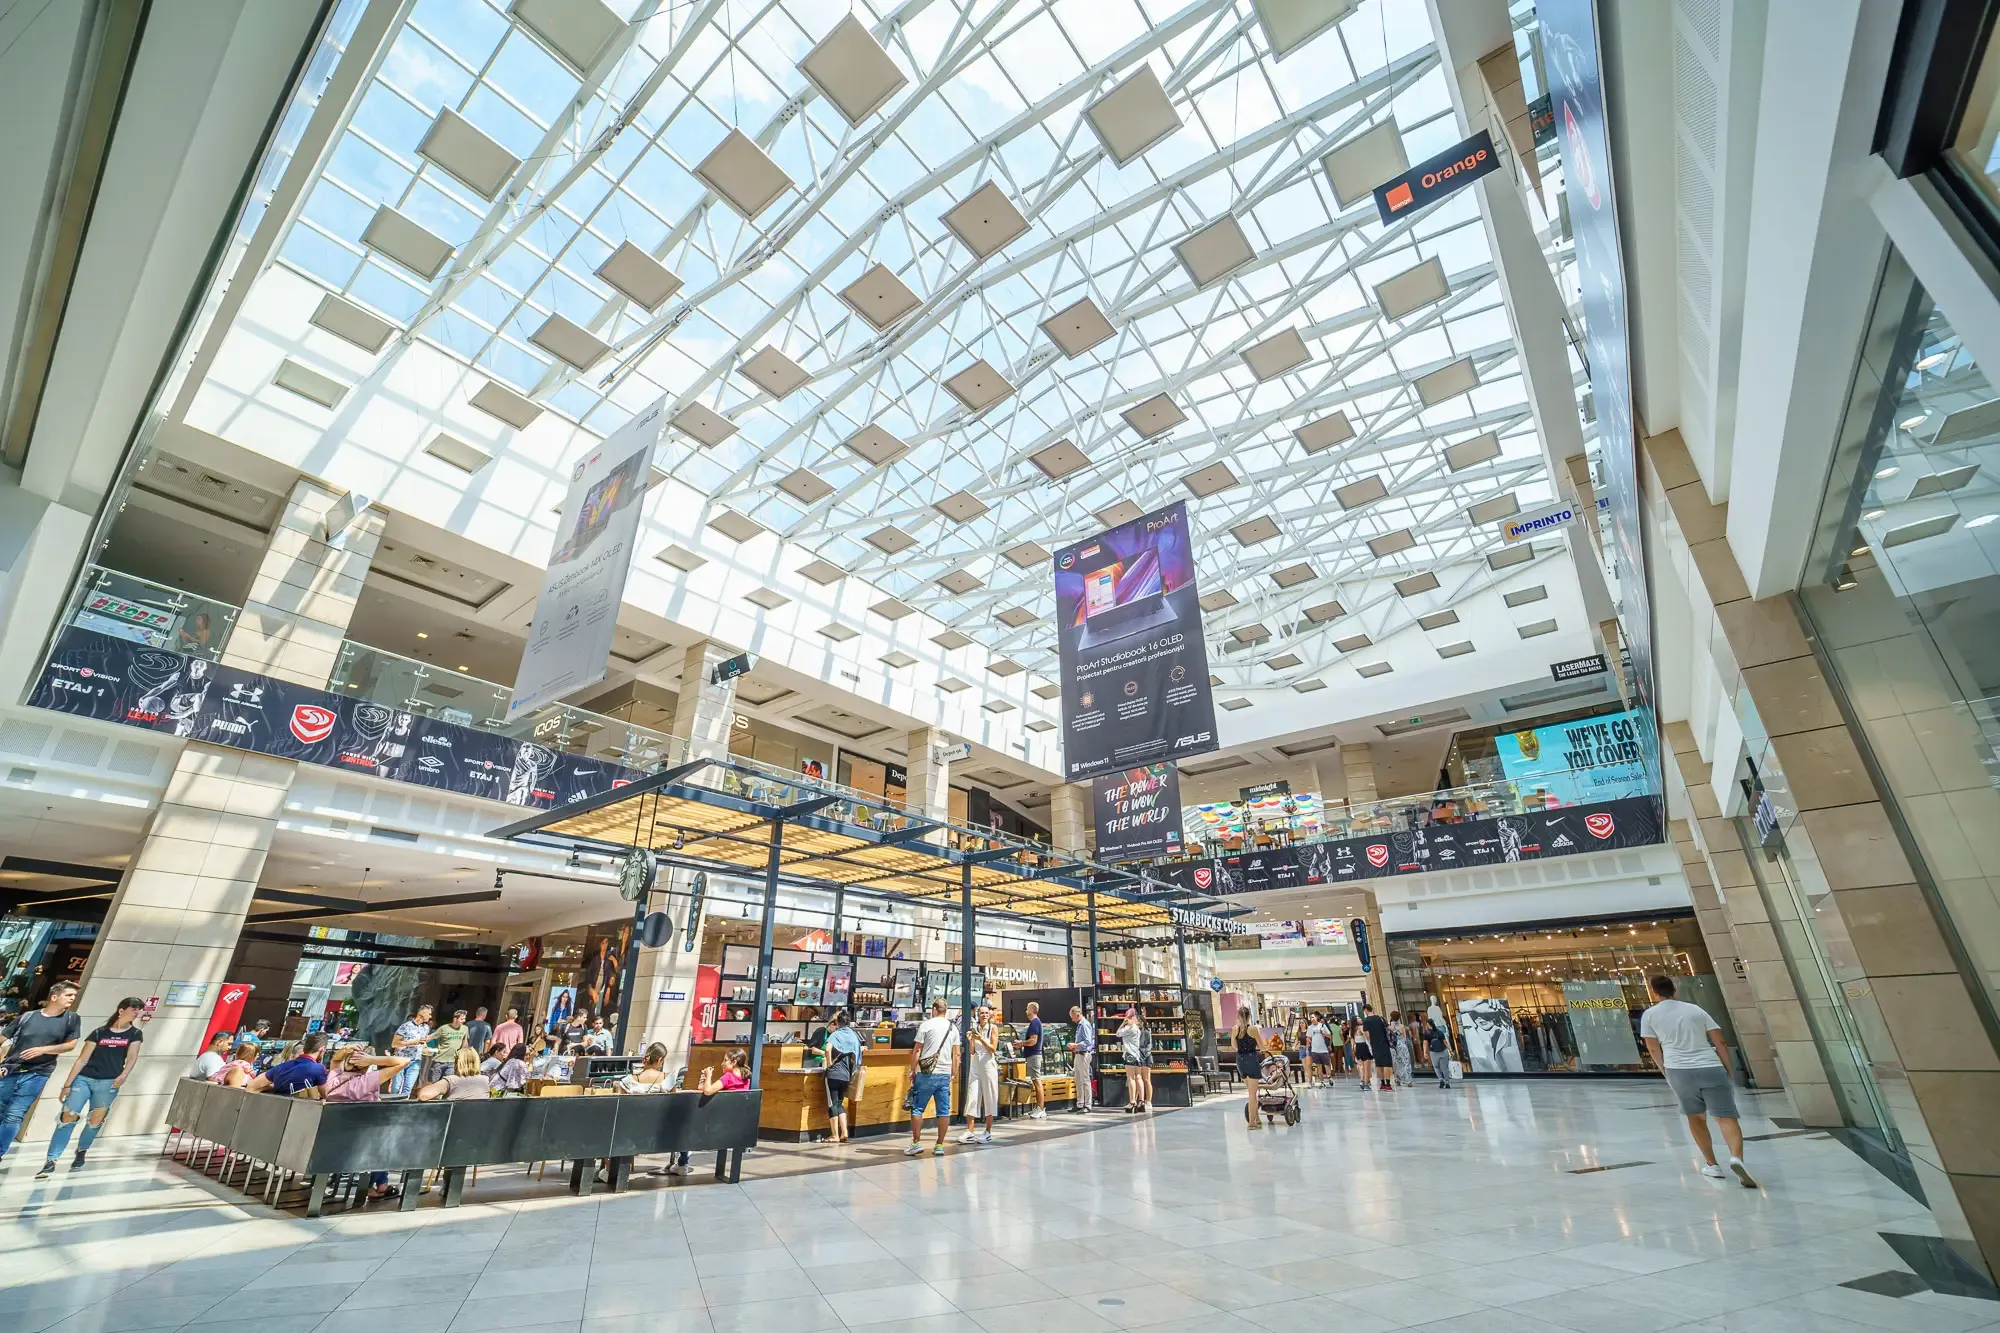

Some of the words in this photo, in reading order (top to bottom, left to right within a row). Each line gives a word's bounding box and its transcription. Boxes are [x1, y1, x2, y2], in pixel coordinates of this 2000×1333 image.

[1421, 149, 1488, 189] Orange
[1146, 513, 1179, 533] ProArt
[1510, 510, 1572, 536] IMPRINTO
[1076, 659, 1101, 674] ProArt
[1101, 645, 1147, 667] Studiobook
[1148, 641, 1159, 652] 16
[1159, 633, 1184, 647] OLED
[51, 662, 81, 674] SPORT
[93, 672, 120, 683] VISION
[1102, 664, 1123, 676] pentru
[1122, 656, 1147, 668] creatorii
[1566, 669, 1580, 677] LASER
[52, 678, 93, 695] ETAJ
[97, 688, 105, 697] 1
[128, 711, 158, 723] LEAP
[533, 715, 562, 738] IQOS
[211, 719, 247, 735] PUMA
[421, 735, 453, 748] ellesse
[1174, 732, 1212, 748] ASUS
[1566, 723, 1612, 751] WE'VE
[464, 757, 484, 766] SPORT
[492, 764, 512, 773] VISION
[1080, 758, 1104, 769] Windows
[1563, 748, 1596, 771] YOU
[418, 765, 440, 774] umbro
[469, 770, 493, 782] ETAJ
[494, 776, 500, 784] 1
[1104, 784, 1129, 803] THE
[1130, 774, 1168, 797] POWER
[1593, 777, 1605, 787] End
[1605, 776, 1611, 785] of
[1611, 774, 1631, 784] Season
[1630, 772, 1646, 781] Sale!
[1114, 800, 1129, 815] TO
[1131, 790, 1160, 811] WOW
[1106, 815, 1130, 834] THE
[1131, 806, 1170, 828] WORLD
[1552, 840, 1574, 849] adidas
[1171, 907, 1222, 932] STARBUCKS
[289, 1000, 304, 1009] ER
[1569, 997, 1625, 1009] MANGO
